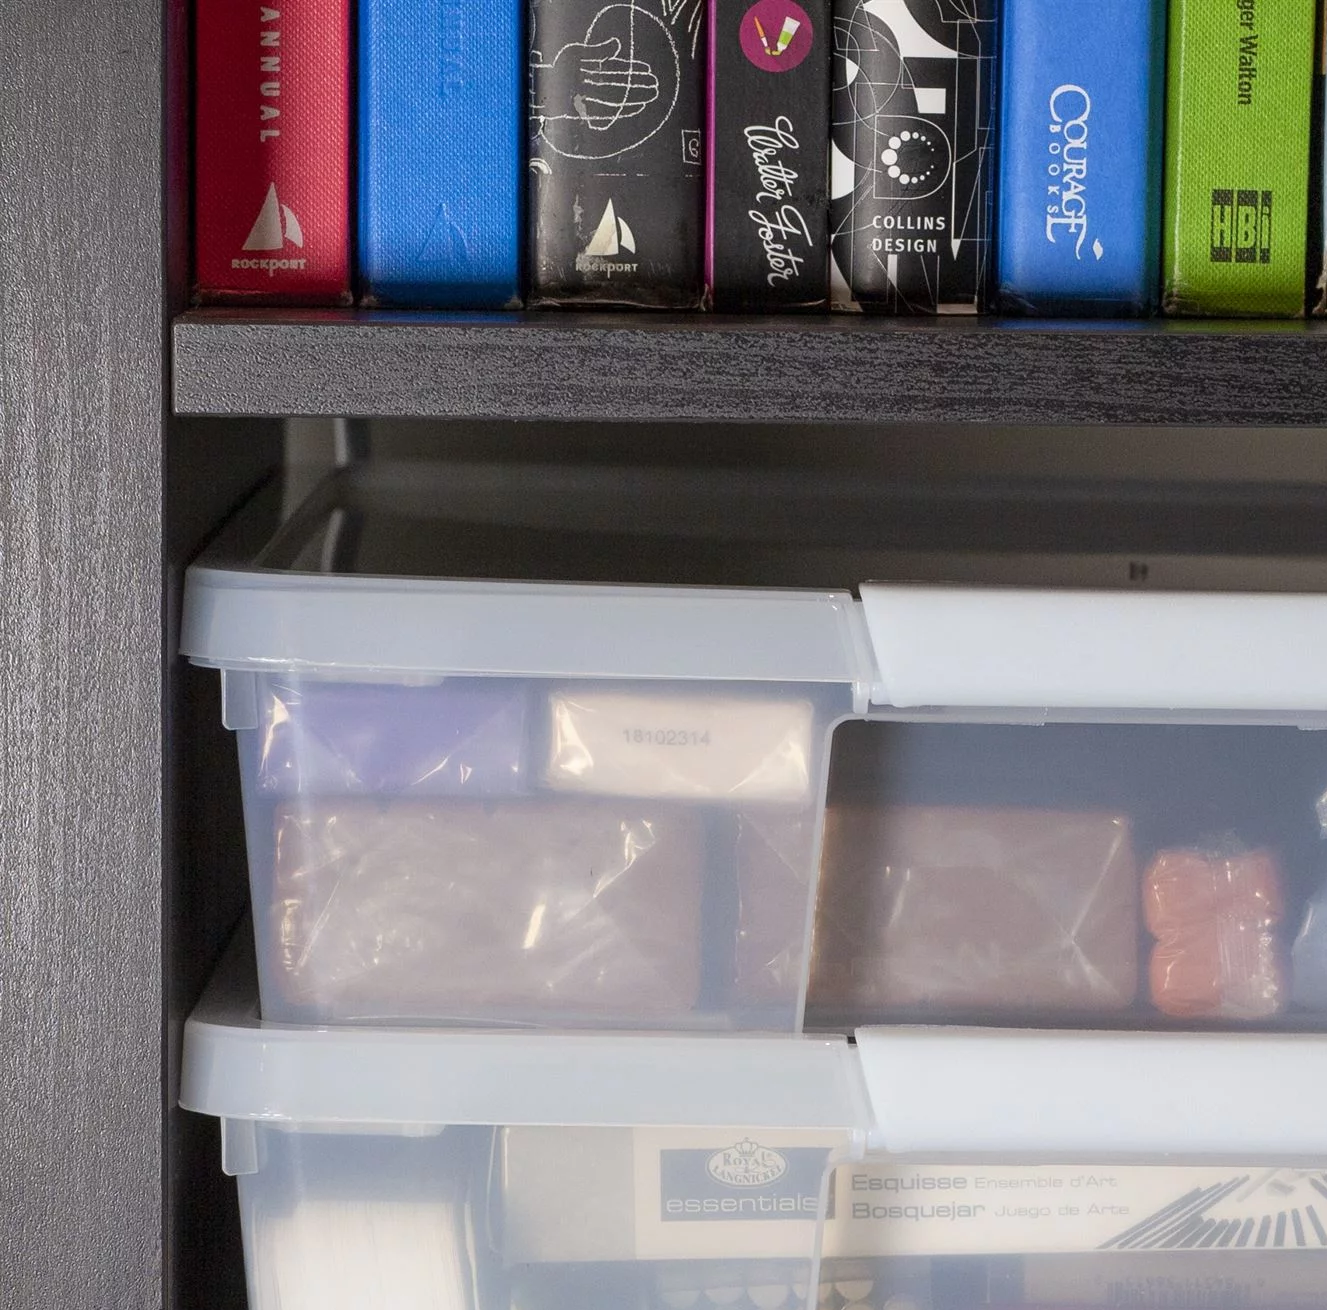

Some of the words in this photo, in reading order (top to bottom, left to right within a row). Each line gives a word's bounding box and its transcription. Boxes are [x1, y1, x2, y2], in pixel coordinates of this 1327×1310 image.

[260, 6, 281, 142] ANNUAL
[1238, 34, 1258, 105] Walton
[743, 115, 800, 203] Walter
[1046, 84, 1091, 260] COURAGE
[1047, 125, 1061, 214] BOOKS
[748, 204, 813, 288] Foster
[872, 215, 945, 231] COLLINS
[872, 238, 937, 253] DESIGN
[622, 728, 711, 746] 18102314
[666, 1192, 819, 1213] essentials
[851, 1173, 968, 1194] Esquisse
[974, 1175, 1063, 1189] Ensemble
[1069, 1174, 1118, 1188] d'Art
[852, 1201, 986, 1221] Bosquejar
[1058, 1204, 1080, 1216] de
[1086, 1203, 1130, 1216] Arte
